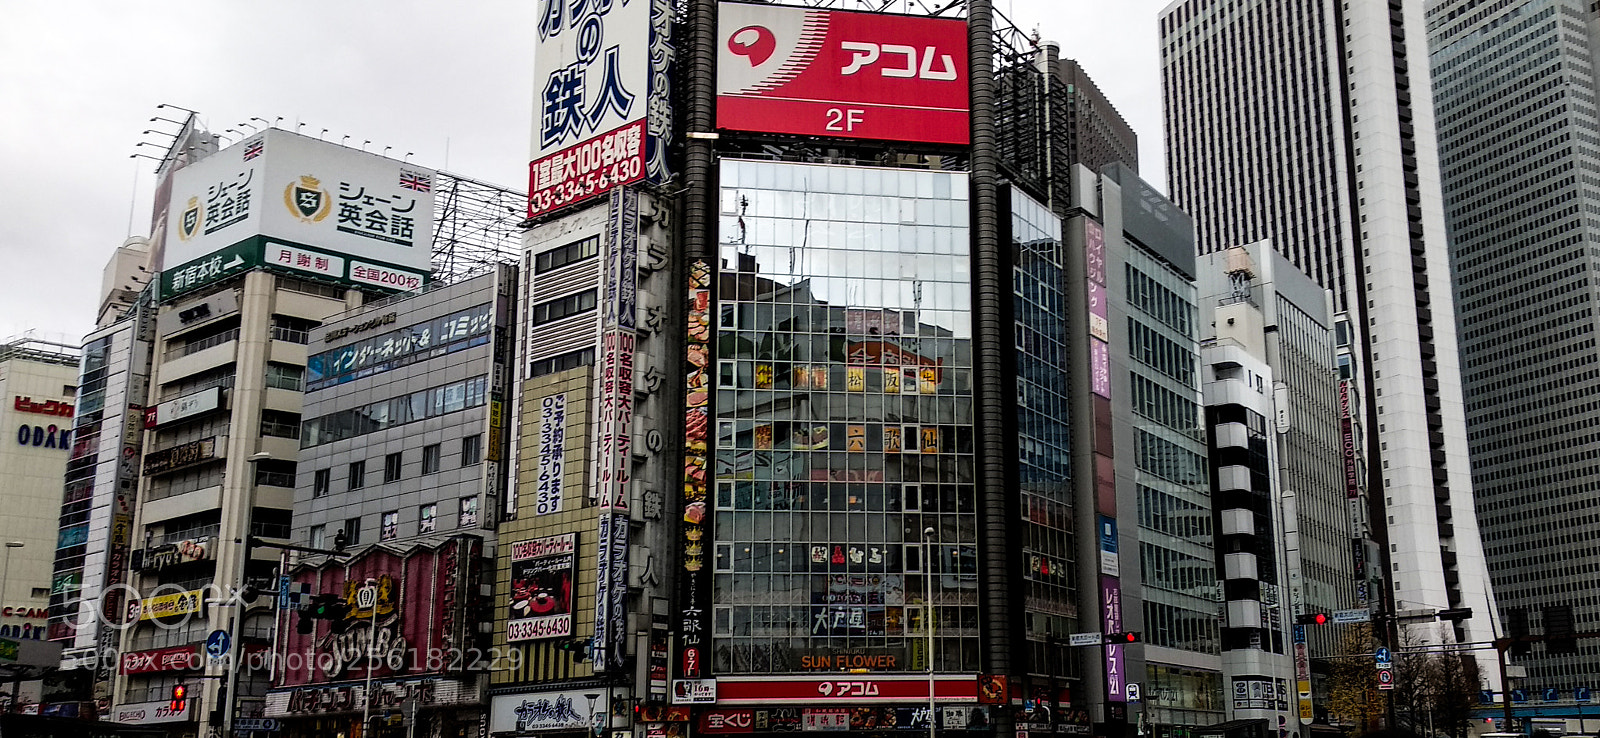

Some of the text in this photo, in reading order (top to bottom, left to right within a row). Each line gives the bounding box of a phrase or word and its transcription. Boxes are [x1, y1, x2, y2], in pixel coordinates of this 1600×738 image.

[841, 40, 959, 82] アコム
[825, 108, 865, 132] 2F
[532, 124, 641, 193] 1室最大100名収容
[208, 167, 254, 204] シェーン
[339, 181, 417, 213] シェーン
[205, 188, 252, 227] 英会話
[337, 202, 415, 240] 英会話
[171, 255, 223, 292] 新宿本校
[277, 249, 329, 272] 月謝制
[352, 265, 421, 290] 全国200校
[333, 335, 418, 373] インターネット
[18, 424, 71, 450] ODAK
[614, 332, 634, 510] 100名収容大パーティールーム
[537, 397, 554, 514] 03-3345-6430
[550, 393, 565, 512] ご予約承ります
[849, 429, 938, 450] 六歌仙
[508, 617, 570, 640] 03-3345-6430
[681, 605, 703, 647] 六歌仙
[813, 606, 866, 635] 大戸屋
[801, 654, 896, 668] SUN FLOWER
[836, 681, 880, 697] アコム
[708, 713, 751, 728] 宝くじ
